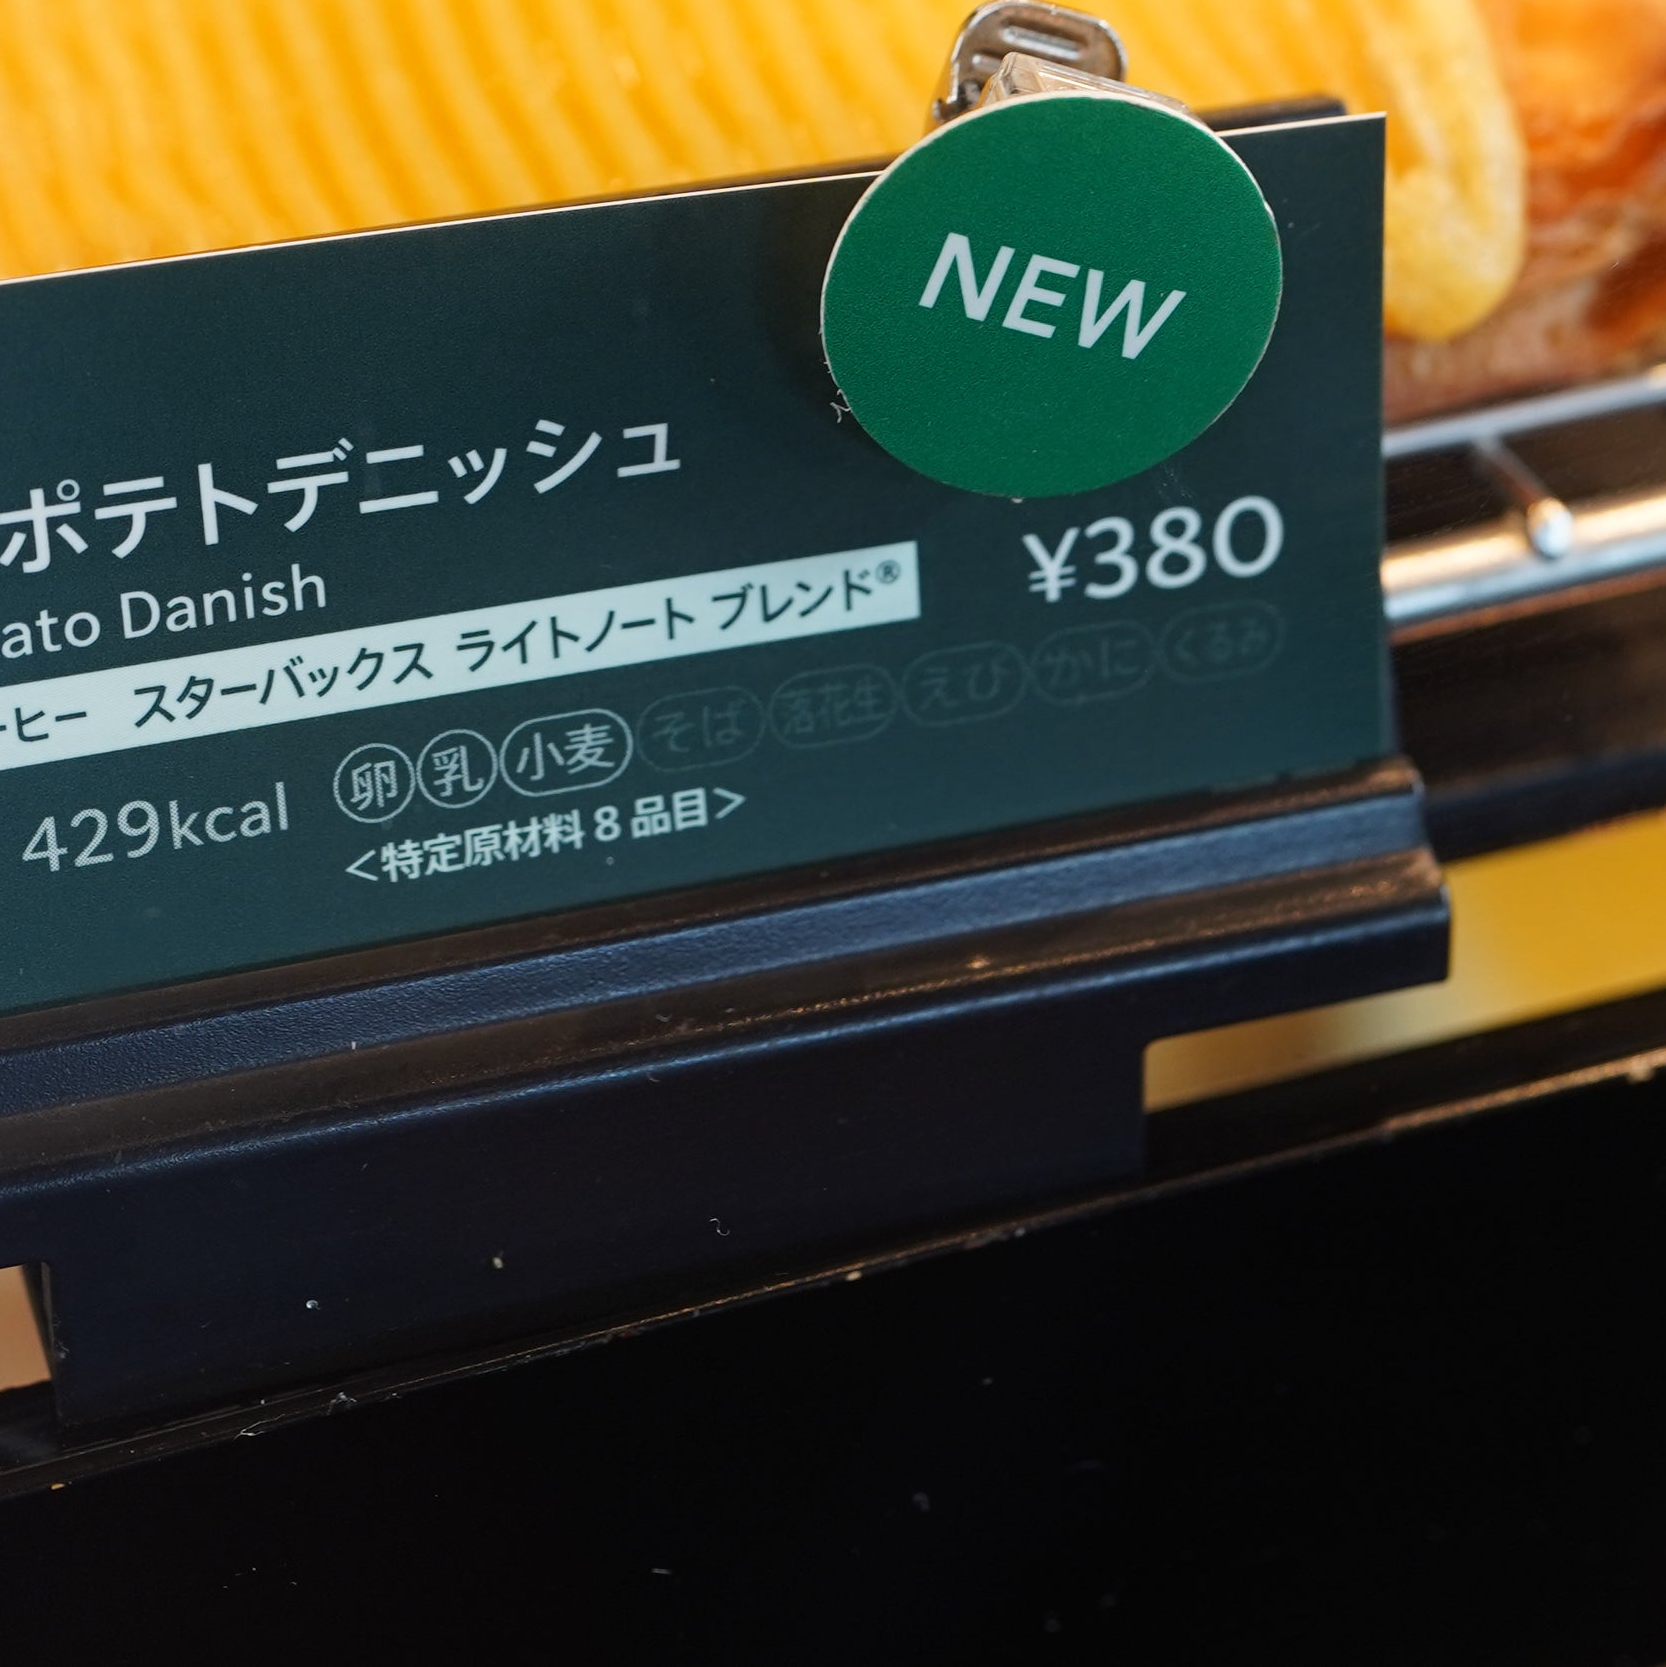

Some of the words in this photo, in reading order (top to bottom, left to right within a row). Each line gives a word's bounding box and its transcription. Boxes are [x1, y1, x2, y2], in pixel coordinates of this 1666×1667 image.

[919, 232, 1187, 360] NEW
[120, 563, 327, 640] Danish
[1023, 495, 1284, 602] ¥380
[133, 640, 433, 728] スターバックス
[456, 596, 695, 670] ライトノート
[348, 758, 400, 812] 卵
[432, 745, 486, 798] 乳
[515, 722, 617, 782] 小麦
[655, 698, 747, 753] そば
[780, 680, 895, 736] 落花生
[919, 655, 1013, 711] えび
[1040, 634, 1141, 692] かに
[21, 781, 290, 873] 429kcal
